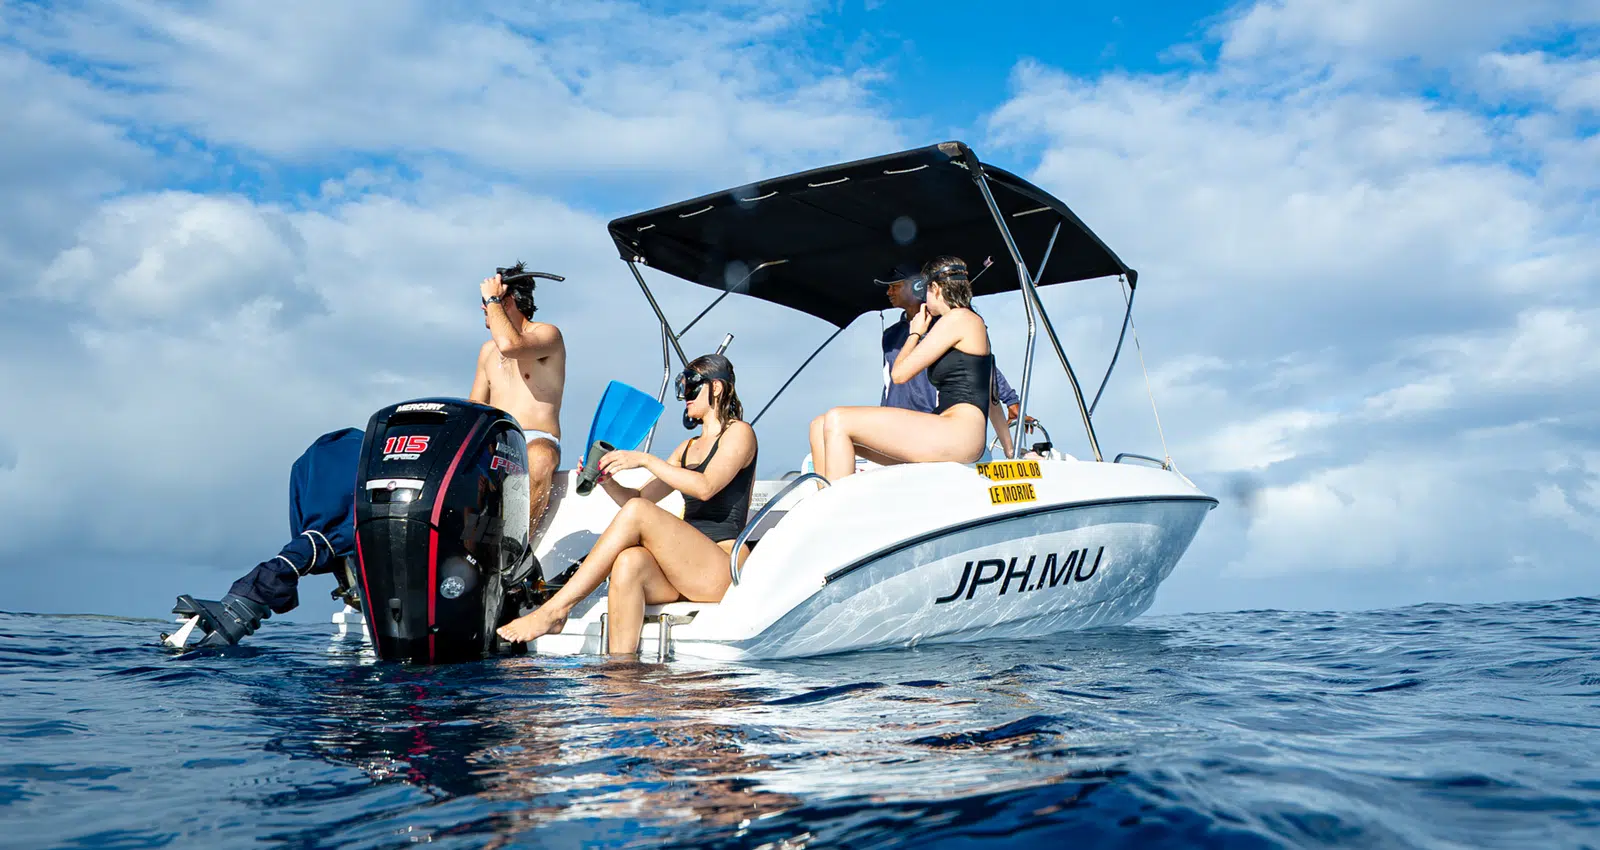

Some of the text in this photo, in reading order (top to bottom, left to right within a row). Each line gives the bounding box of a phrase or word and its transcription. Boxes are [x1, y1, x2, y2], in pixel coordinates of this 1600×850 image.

[396, 403, 445, 412] MERCURY
[383, 436, 430, 454] 115
[993, 464, 1015, 478] 4071
[1029, 463, 1041, 476] 08
[990, 484, 1035, 503] LE MORNE
[935, 546, 1104, 604] JPH.MU
